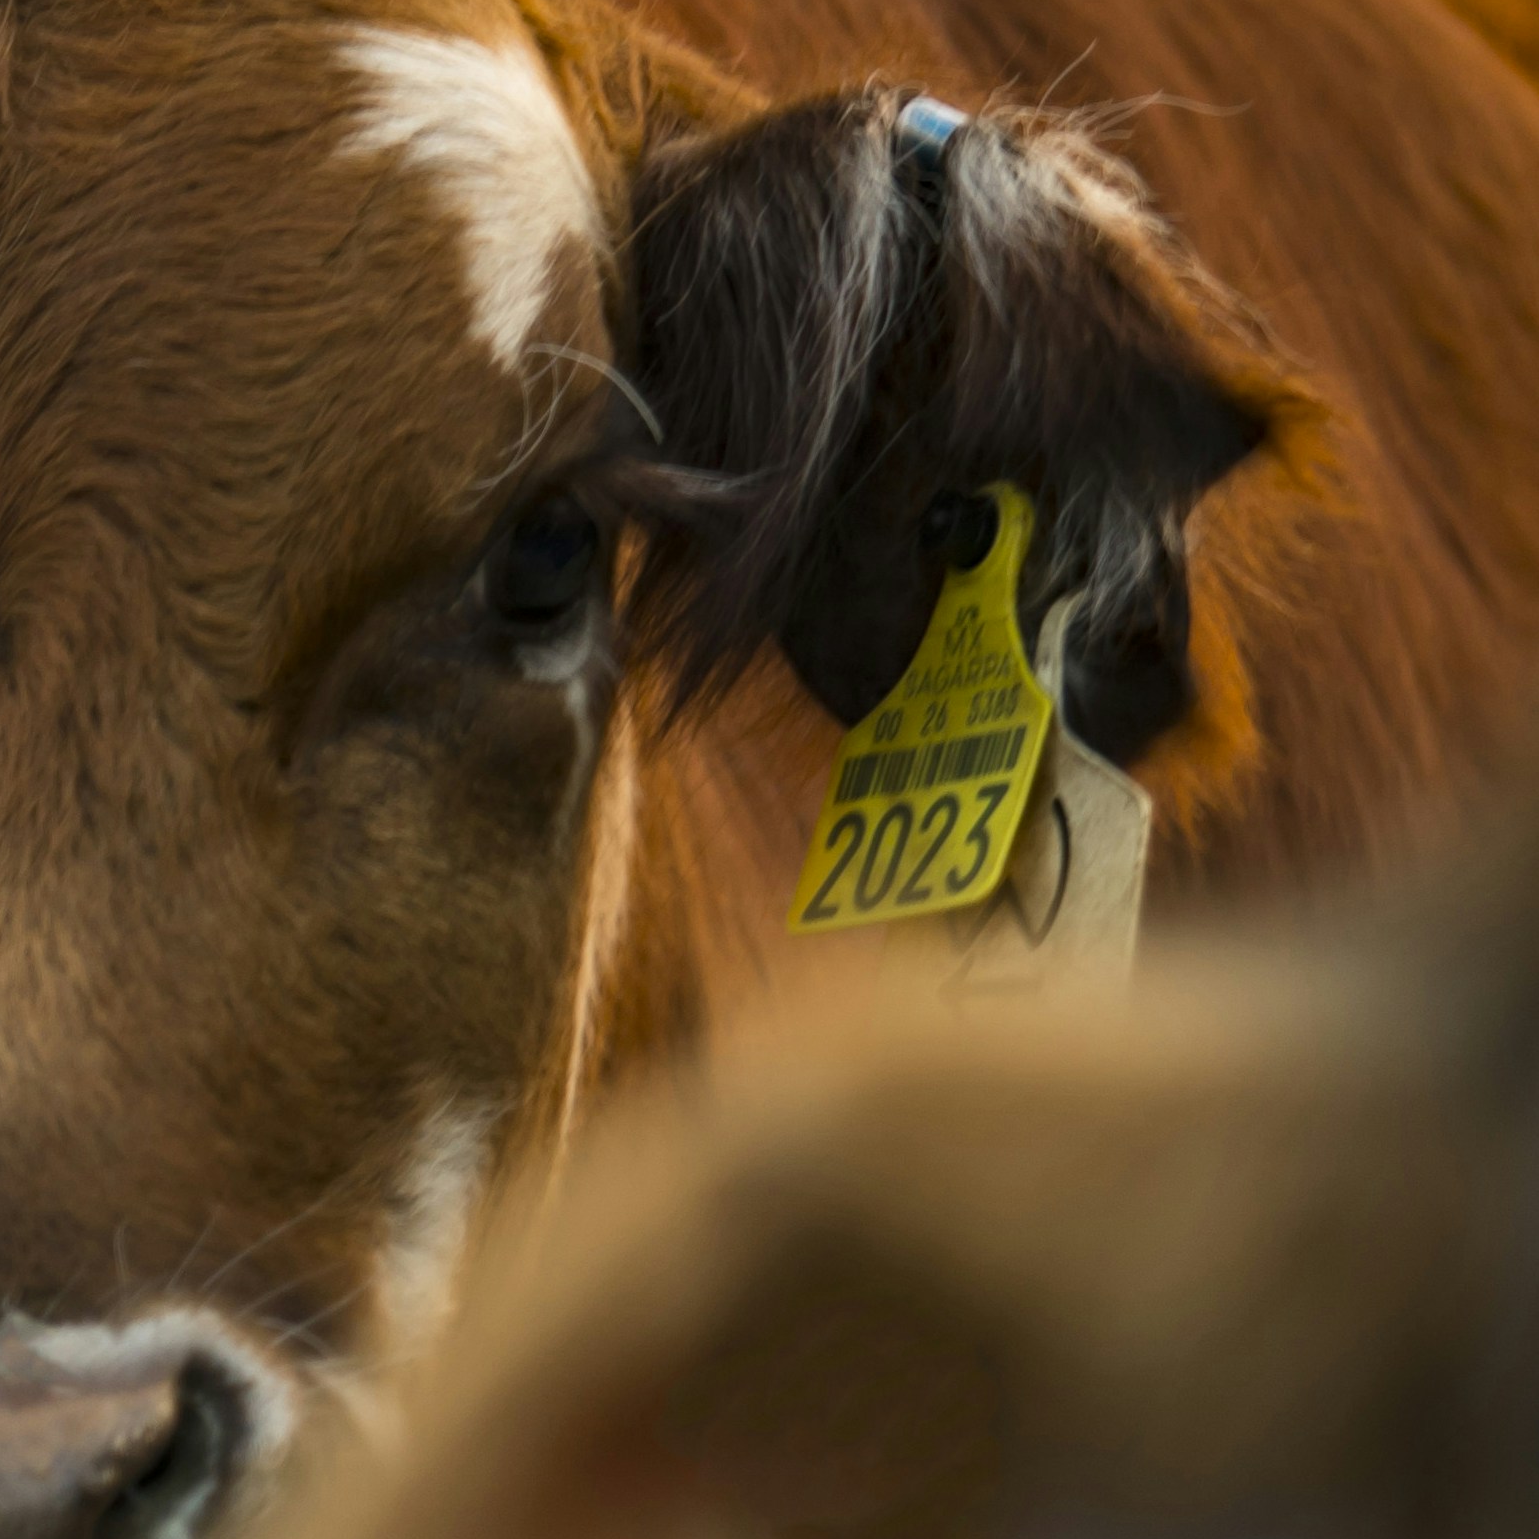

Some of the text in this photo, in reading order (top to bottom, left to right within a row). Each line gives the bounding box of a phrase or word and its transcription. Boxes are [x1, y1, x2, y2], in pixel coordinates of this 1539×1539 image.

[873, 707, 903, 743] 00
[920, 699, 948, 737] 26
[800, 783, 1009, 922] 2023
